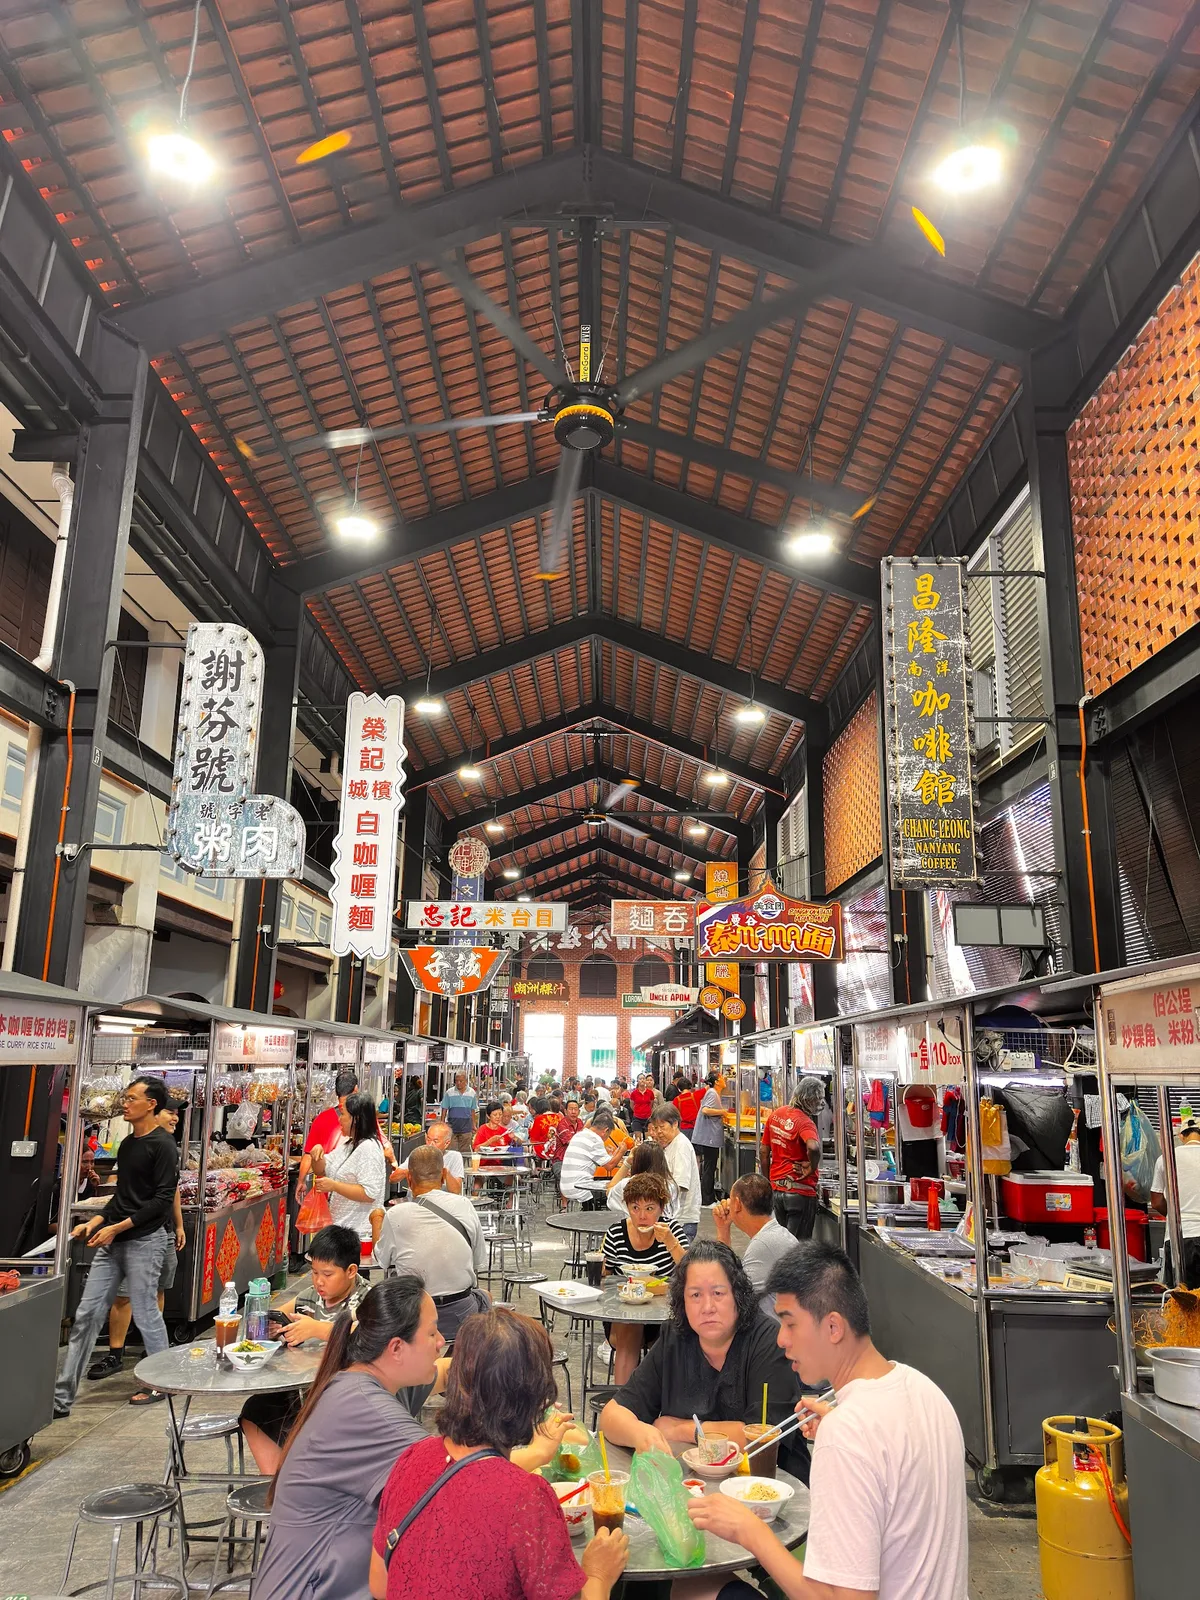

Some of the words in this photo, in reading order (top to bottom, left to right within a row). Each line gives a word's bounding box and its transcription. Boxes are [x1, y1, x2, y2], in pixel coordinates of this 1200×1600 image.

[904, 819, 935, 838] CHANG
[939, 819, 970, 839] LEONG
[916, 842, 961, 854] NANYANG
[921, 857, 957, 869] COFFEE
[670, 993, 691, 1002] APOM
[1153, 987, 1193, 1017] 伯公埕
[7, 1040, 26, 1049] CURRY
[27, 1041, 40, 1050] RICE
[41, 1042, 57, 1050] STALL
